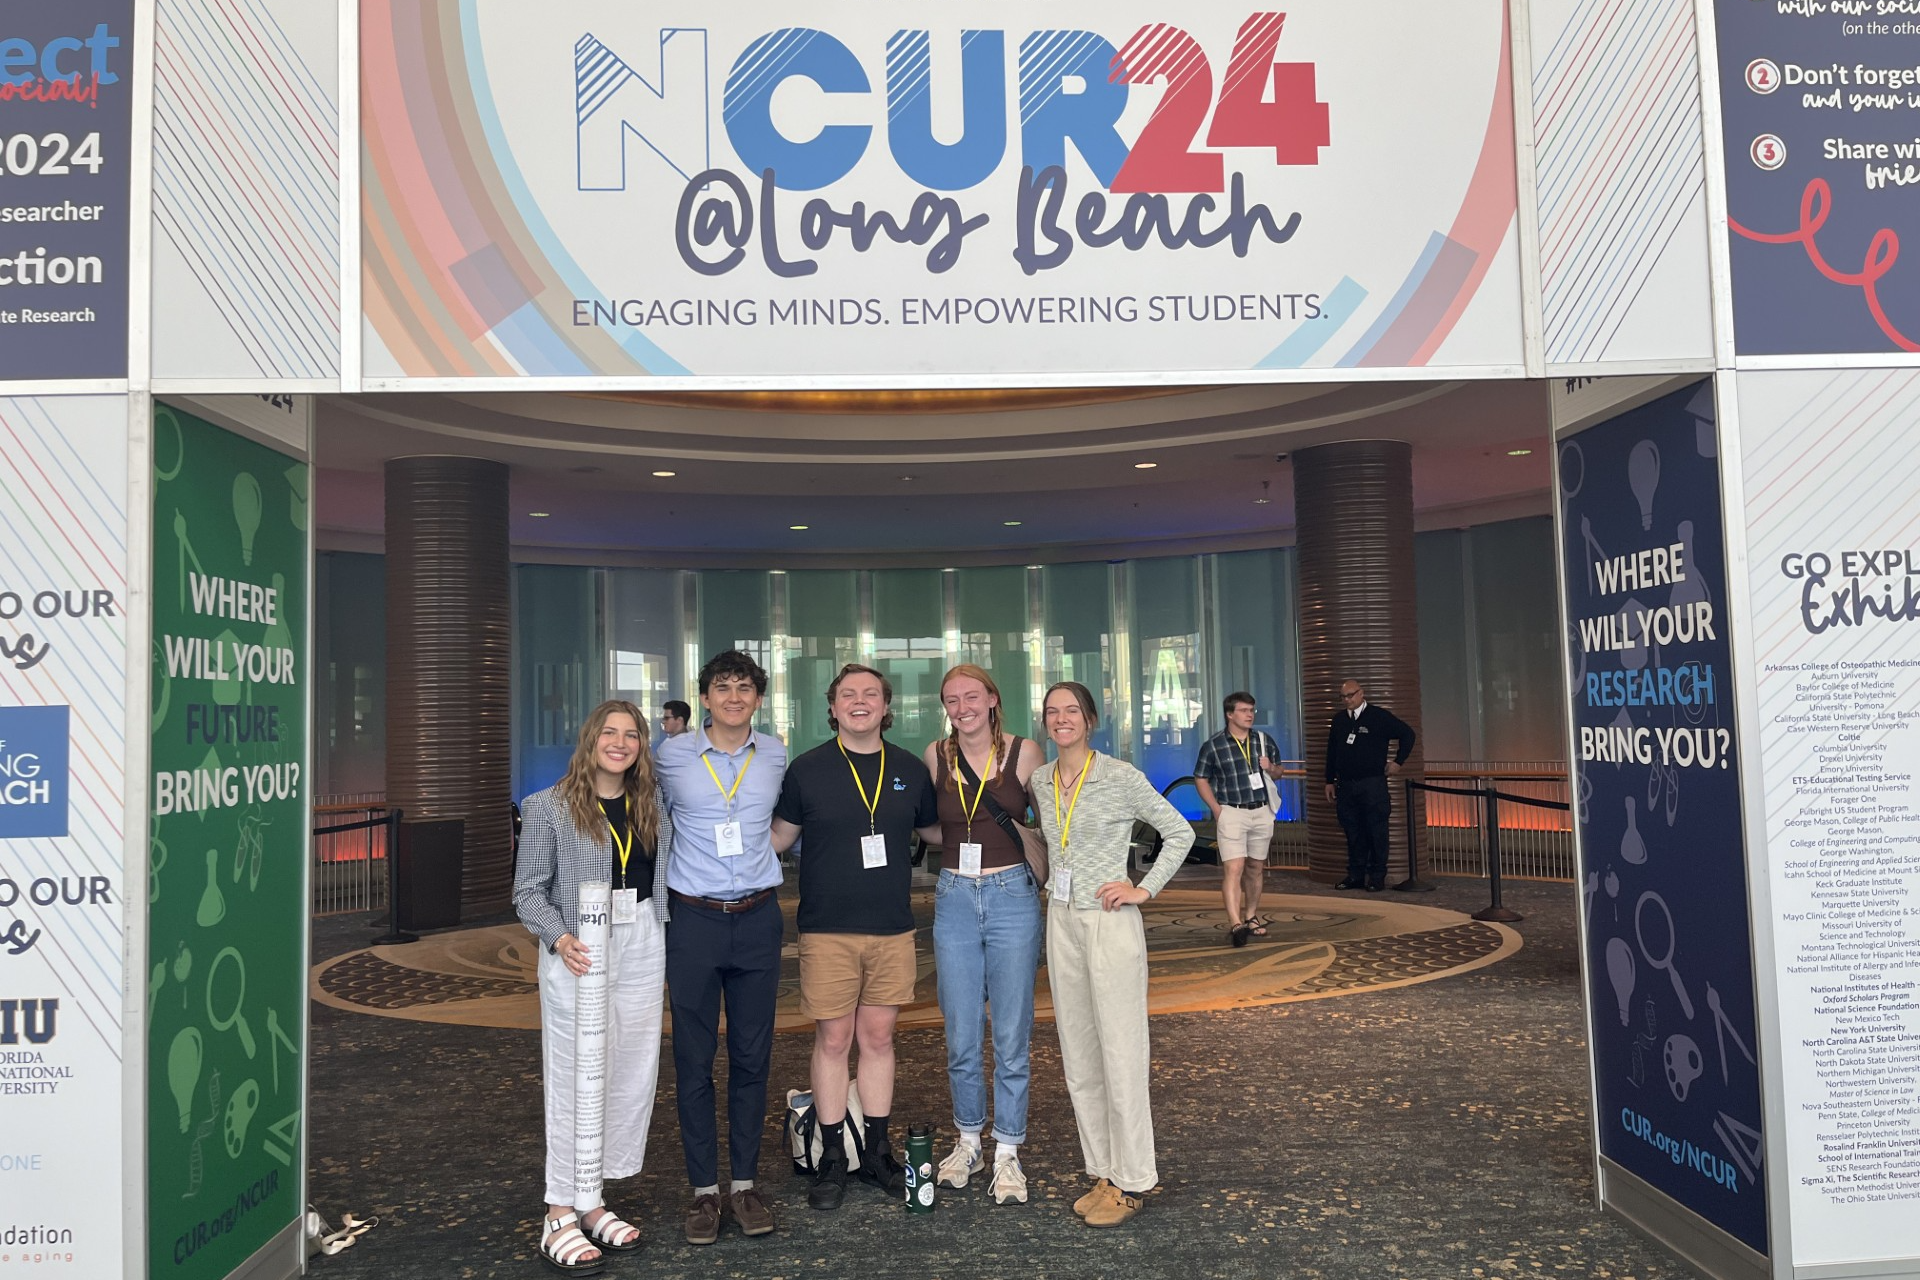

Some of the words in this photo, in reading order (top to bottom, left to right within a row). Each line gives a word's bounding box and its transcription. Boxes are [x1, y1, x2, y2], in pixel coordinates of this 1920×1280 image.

[1831, 0, 1871, 16] our
[1842, 20, 1863, 36] (on
[1866, 21, 1889, 35] the
[1784, 64, 1849, 85] Don't
[1802, 88, 1843, 110] and
[1849, 93, 1905, 112] your
[0, 132, 104, 176] 024
[1823, 138, 1889, 159] Share
[0, 200, 104, 222] searcher
[1013, 164, 1303, 276] Beach
[22, 308, 95, 323] Research
[572, 298, 759, 327] ENGAGING
[768, 297, 892, 325] MINDS.
[902, 294, 1141, 325] EMPOWERING
[1147, 292, 1329, 323] STUDENTS.
[1595, 542, 1685, 595] WHERE
[1780, 552, 1832, 579] GO
[32, 590, 116, 618] OUR
[189, 571, 277, 625] WHERE
[1579, 612, 1635, 652] WILL
[1636, 601, 1716, 647] YOUR
[164, 634, 229, 680] WILL
[233, 642, 295, 684] YOUR
[1802, 662, 1829, 671] College
[1841, 661, 1886, 670] Osteopathic
[1841, 671, 1878, 680] University
[1586, 664, 1714, 706] RESEARCH
[1796, 693, 1831, 701] California
[1833, 692, 1852, 700] State
[1854, 691, 1896, 700] Polytechnic
[186, 704, 279, 744] FUTURE
[1581, 727, 1651, 765] BRING
[1654, 727, 1730, 769] YOU?
[1812, 744, 1848, 753] Columbia
[1850, 743, 1887, 752] University
[1820, 765, 1843, 774] Emory
[1845, 764, 1883, 772] University
[1792, 776, 1854, 785] ETS-Educational
[1856, 775, 1882, 783] Testing
[0, 780, 49, 804] CH
[156, 766, 239, 815] BRING
[242, 762, 300, 804] YOU?
[1790, 840, 1816, 848] College
[1826, 838, 1867, 847] Engineering
[1820, 849, 1846, 857] George
[1848, 847, 1894, 856] Washington,
[30, 876, 112, 906] OUR
[1836, 879, 1870, 887] Graduate
[1822, 901, 1860, 909] Marquette
[1863, 899, 1900, 907] University
[1810, 985, 1842, 994] National
[1844, 984, 1880, 992] Institutes
[1823, 995, 1848, 1003] Oxford
[1849, 994, 1878, 1002] Scholars
[1880, 993, 1910, 1001] Program
[1814, 1006, 1846, 1014] National
[1848, 1005, 1876, 1013] Science
[1878, 1002, 1919, 1011] Foundation
[1868, 1024, 1906, 1032] University
[1803, 1039, 1825, 1047] North
[1826, 1037, 1857, 1045] Carolina
[1877, 1035, 1895, 1043] State
[1826, 1078, 1876, 1088] Northwestern
[1879, 1076, 1916, 1084] University,
[1874, 1119, 1910, 1128] University
[1621, 1107, 1738, 1194] CUR.org/NCUR
[1818, 1154, 1843, 1162] School
[1854, 1150, 1901, 1159] International
[1827, 1165, 1847, 1173] SENS
[1849, 1162, 1881, 1171] Research
[1802, 1177, 1824, 1186] Sigma
[1853, 1172, 1886, 1181] Scientific
[1847, 1195, 1865, 1203] Ohio
[1867, 1193, 1885, 1202] State
[174, 1168, 278, 1265] CUR.org/NCUR
[0, 1225, 73, 1246] dation
